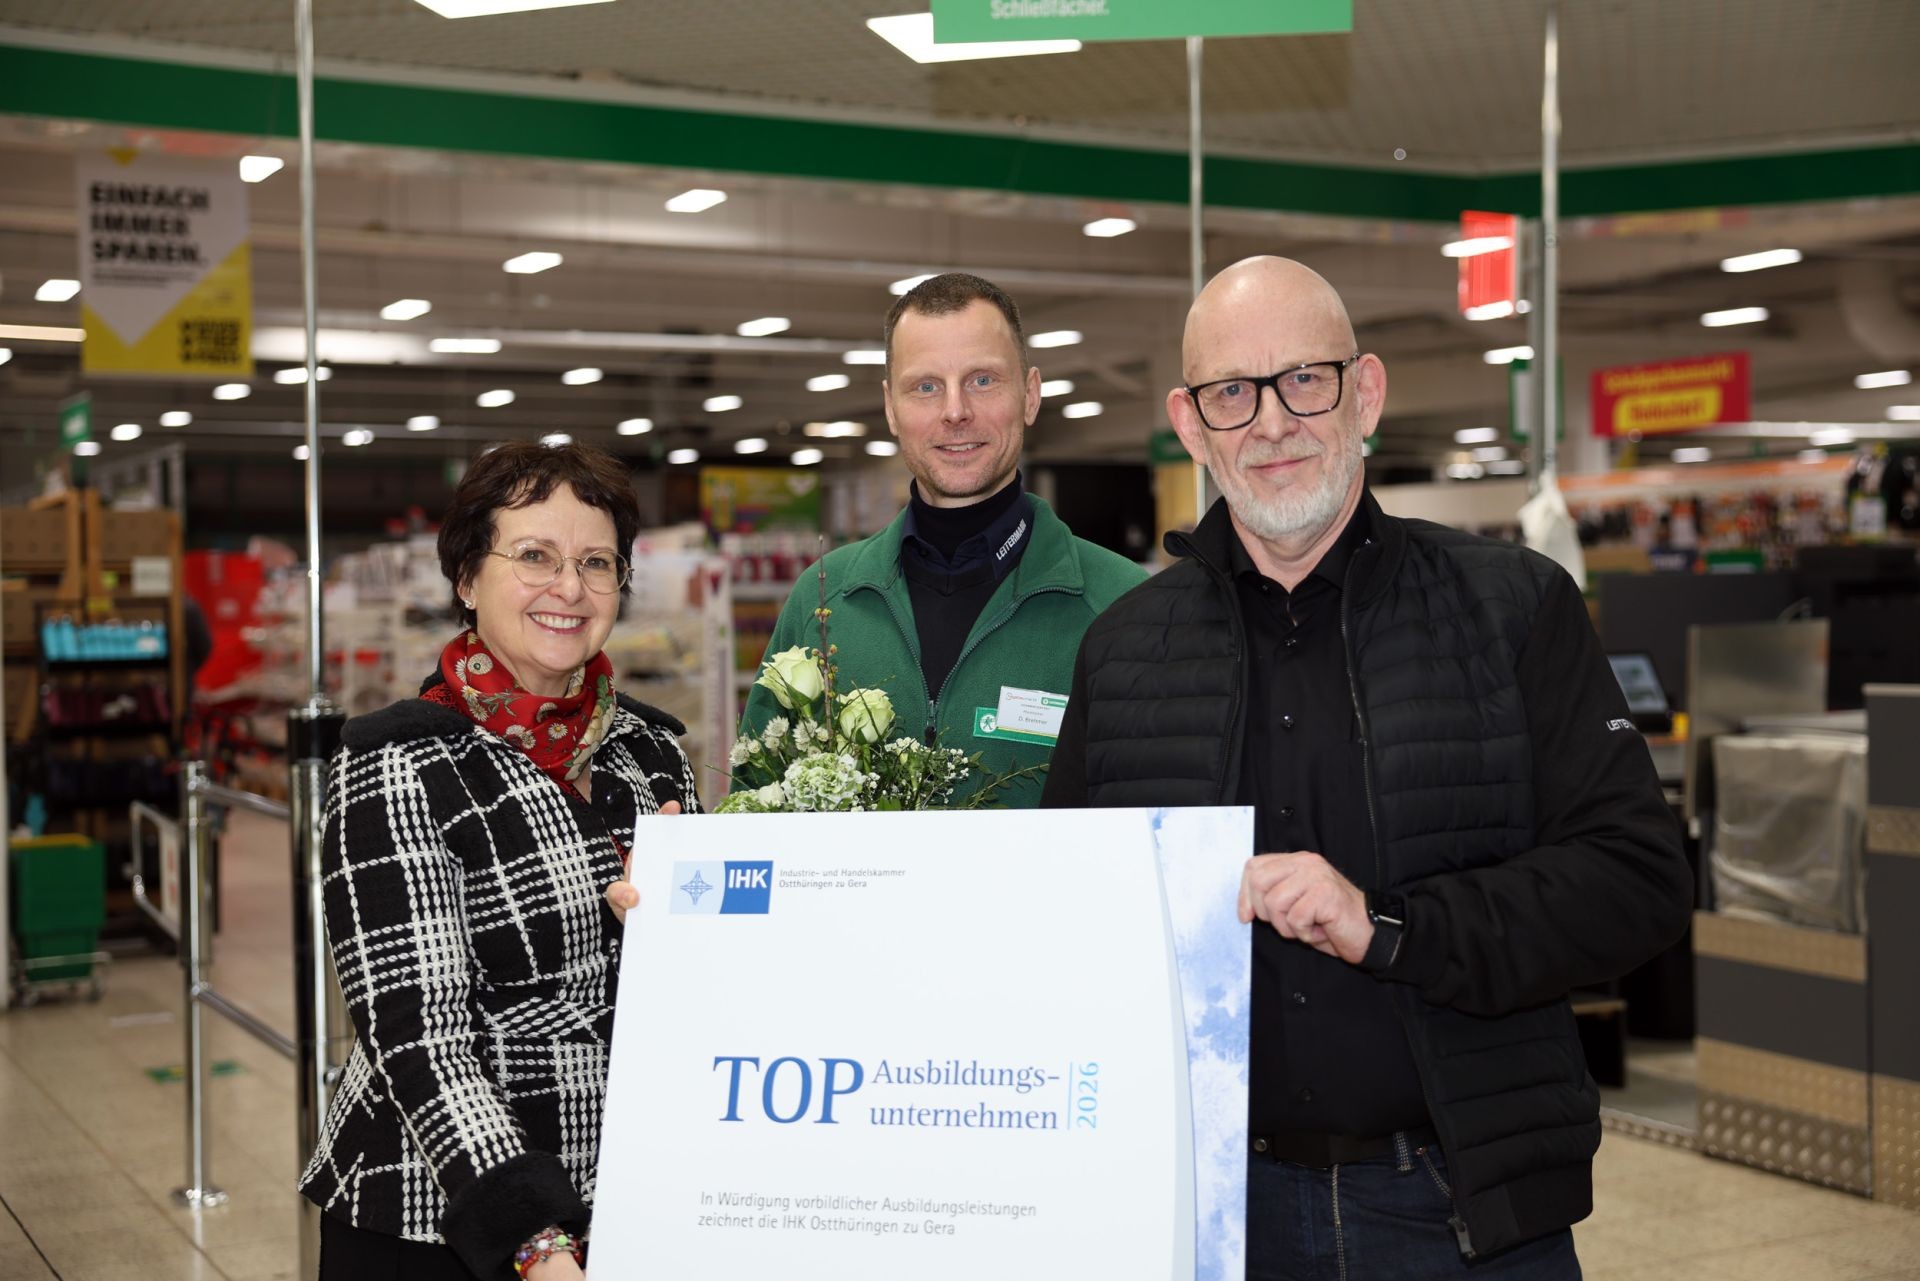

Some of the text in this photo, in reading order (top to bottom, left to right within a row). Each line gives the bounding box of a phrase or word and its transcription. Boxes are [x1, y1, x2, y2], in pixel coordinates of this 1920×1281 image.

[90, 182, 209, 211] EINFACH
[90, 212, 189, 237] IMMER
[92, 239, 208, 266] SPAREN.
[727, 868, 769, 889] IHK
[779, 879, 834, 890] Ostthüringen
[848, 879, 867, 888] Gera
[780, 868, 906, 878] Industrie- und Handelskammer
[713, 1056, 864, 1124] TOP
[872, 1060, 1060, 1094] Ausbildungs-
[1076, 1061, 1099, 1129] 2026
[870, 1102, 1057, 1130] unternehmen
[701, 1191, 1036, 1221] In Würdigung vorbildlicher Ausbildungsleistungen
[698, 1213, 955, 1236] zeichnet die IHK Ostthüringen zu Gera
